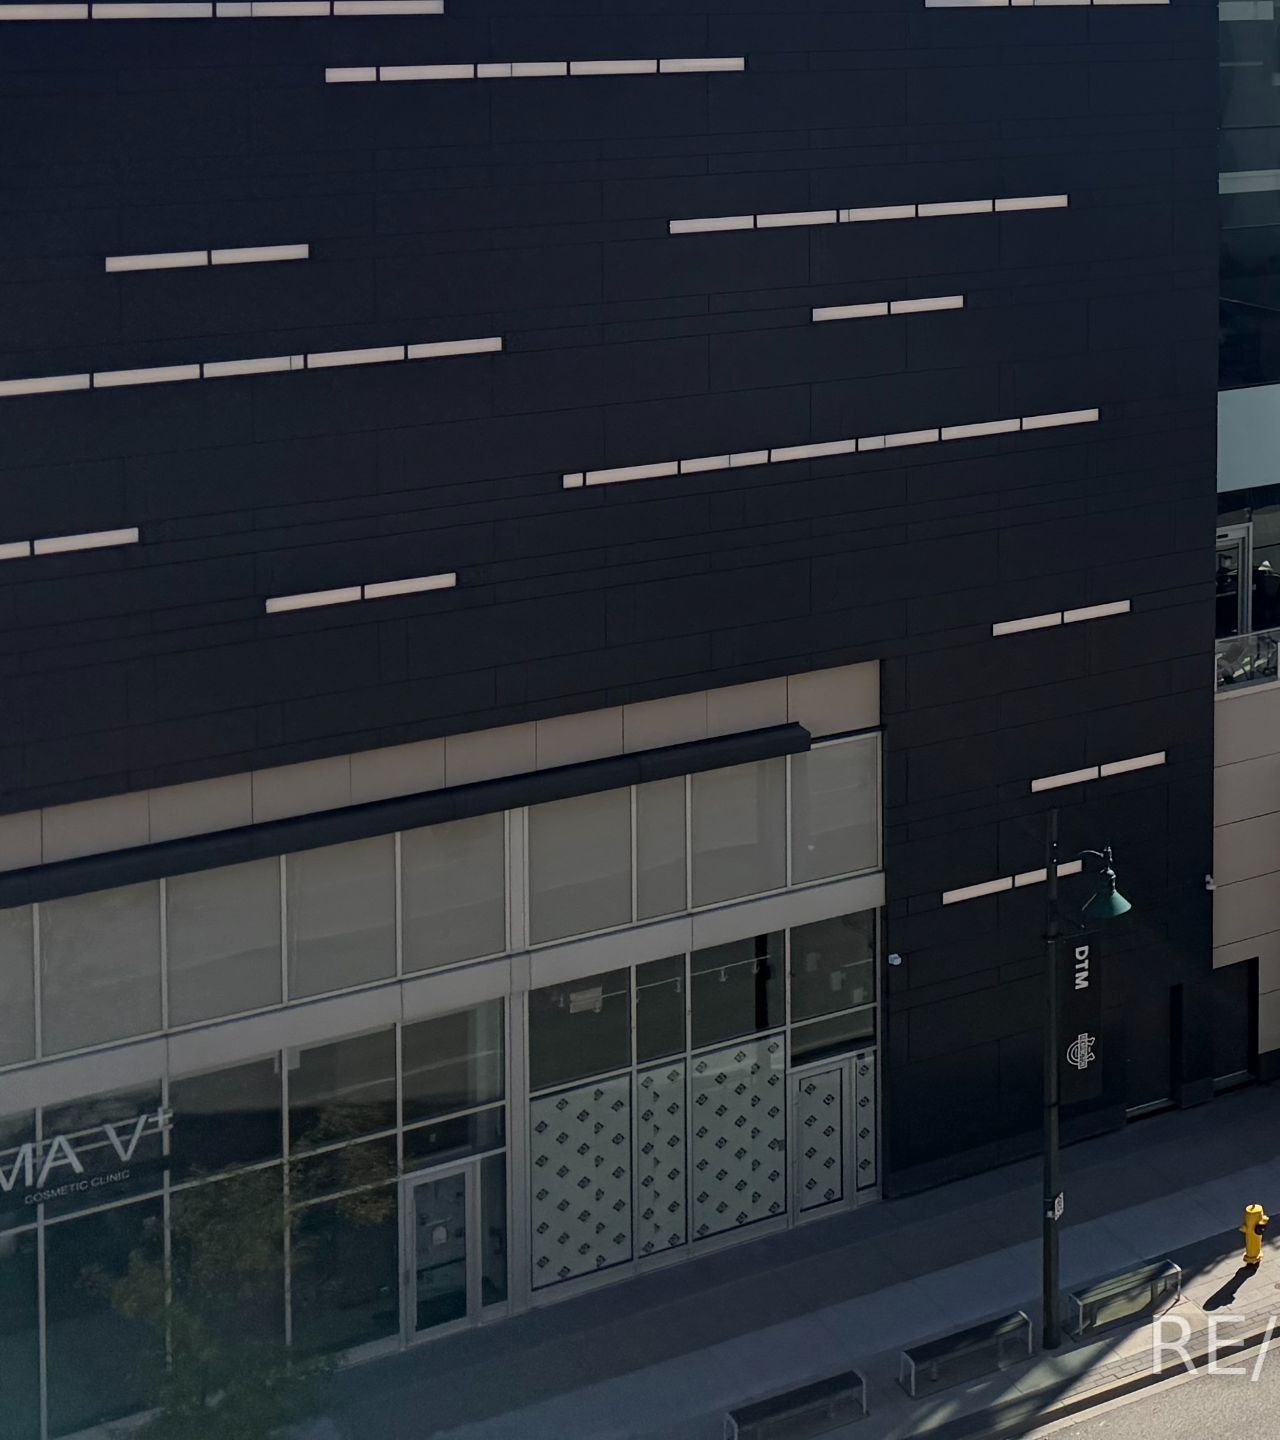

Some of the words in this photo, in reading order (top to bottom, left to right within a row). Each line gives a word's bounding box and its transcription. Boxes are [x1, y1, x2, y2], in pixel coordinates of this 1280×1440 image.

[1075, 945, 1089, 990] DTM
[25, 1180, 89, 1205] COSMETIC
[91, 1169, 131, 1187] CLINIC
